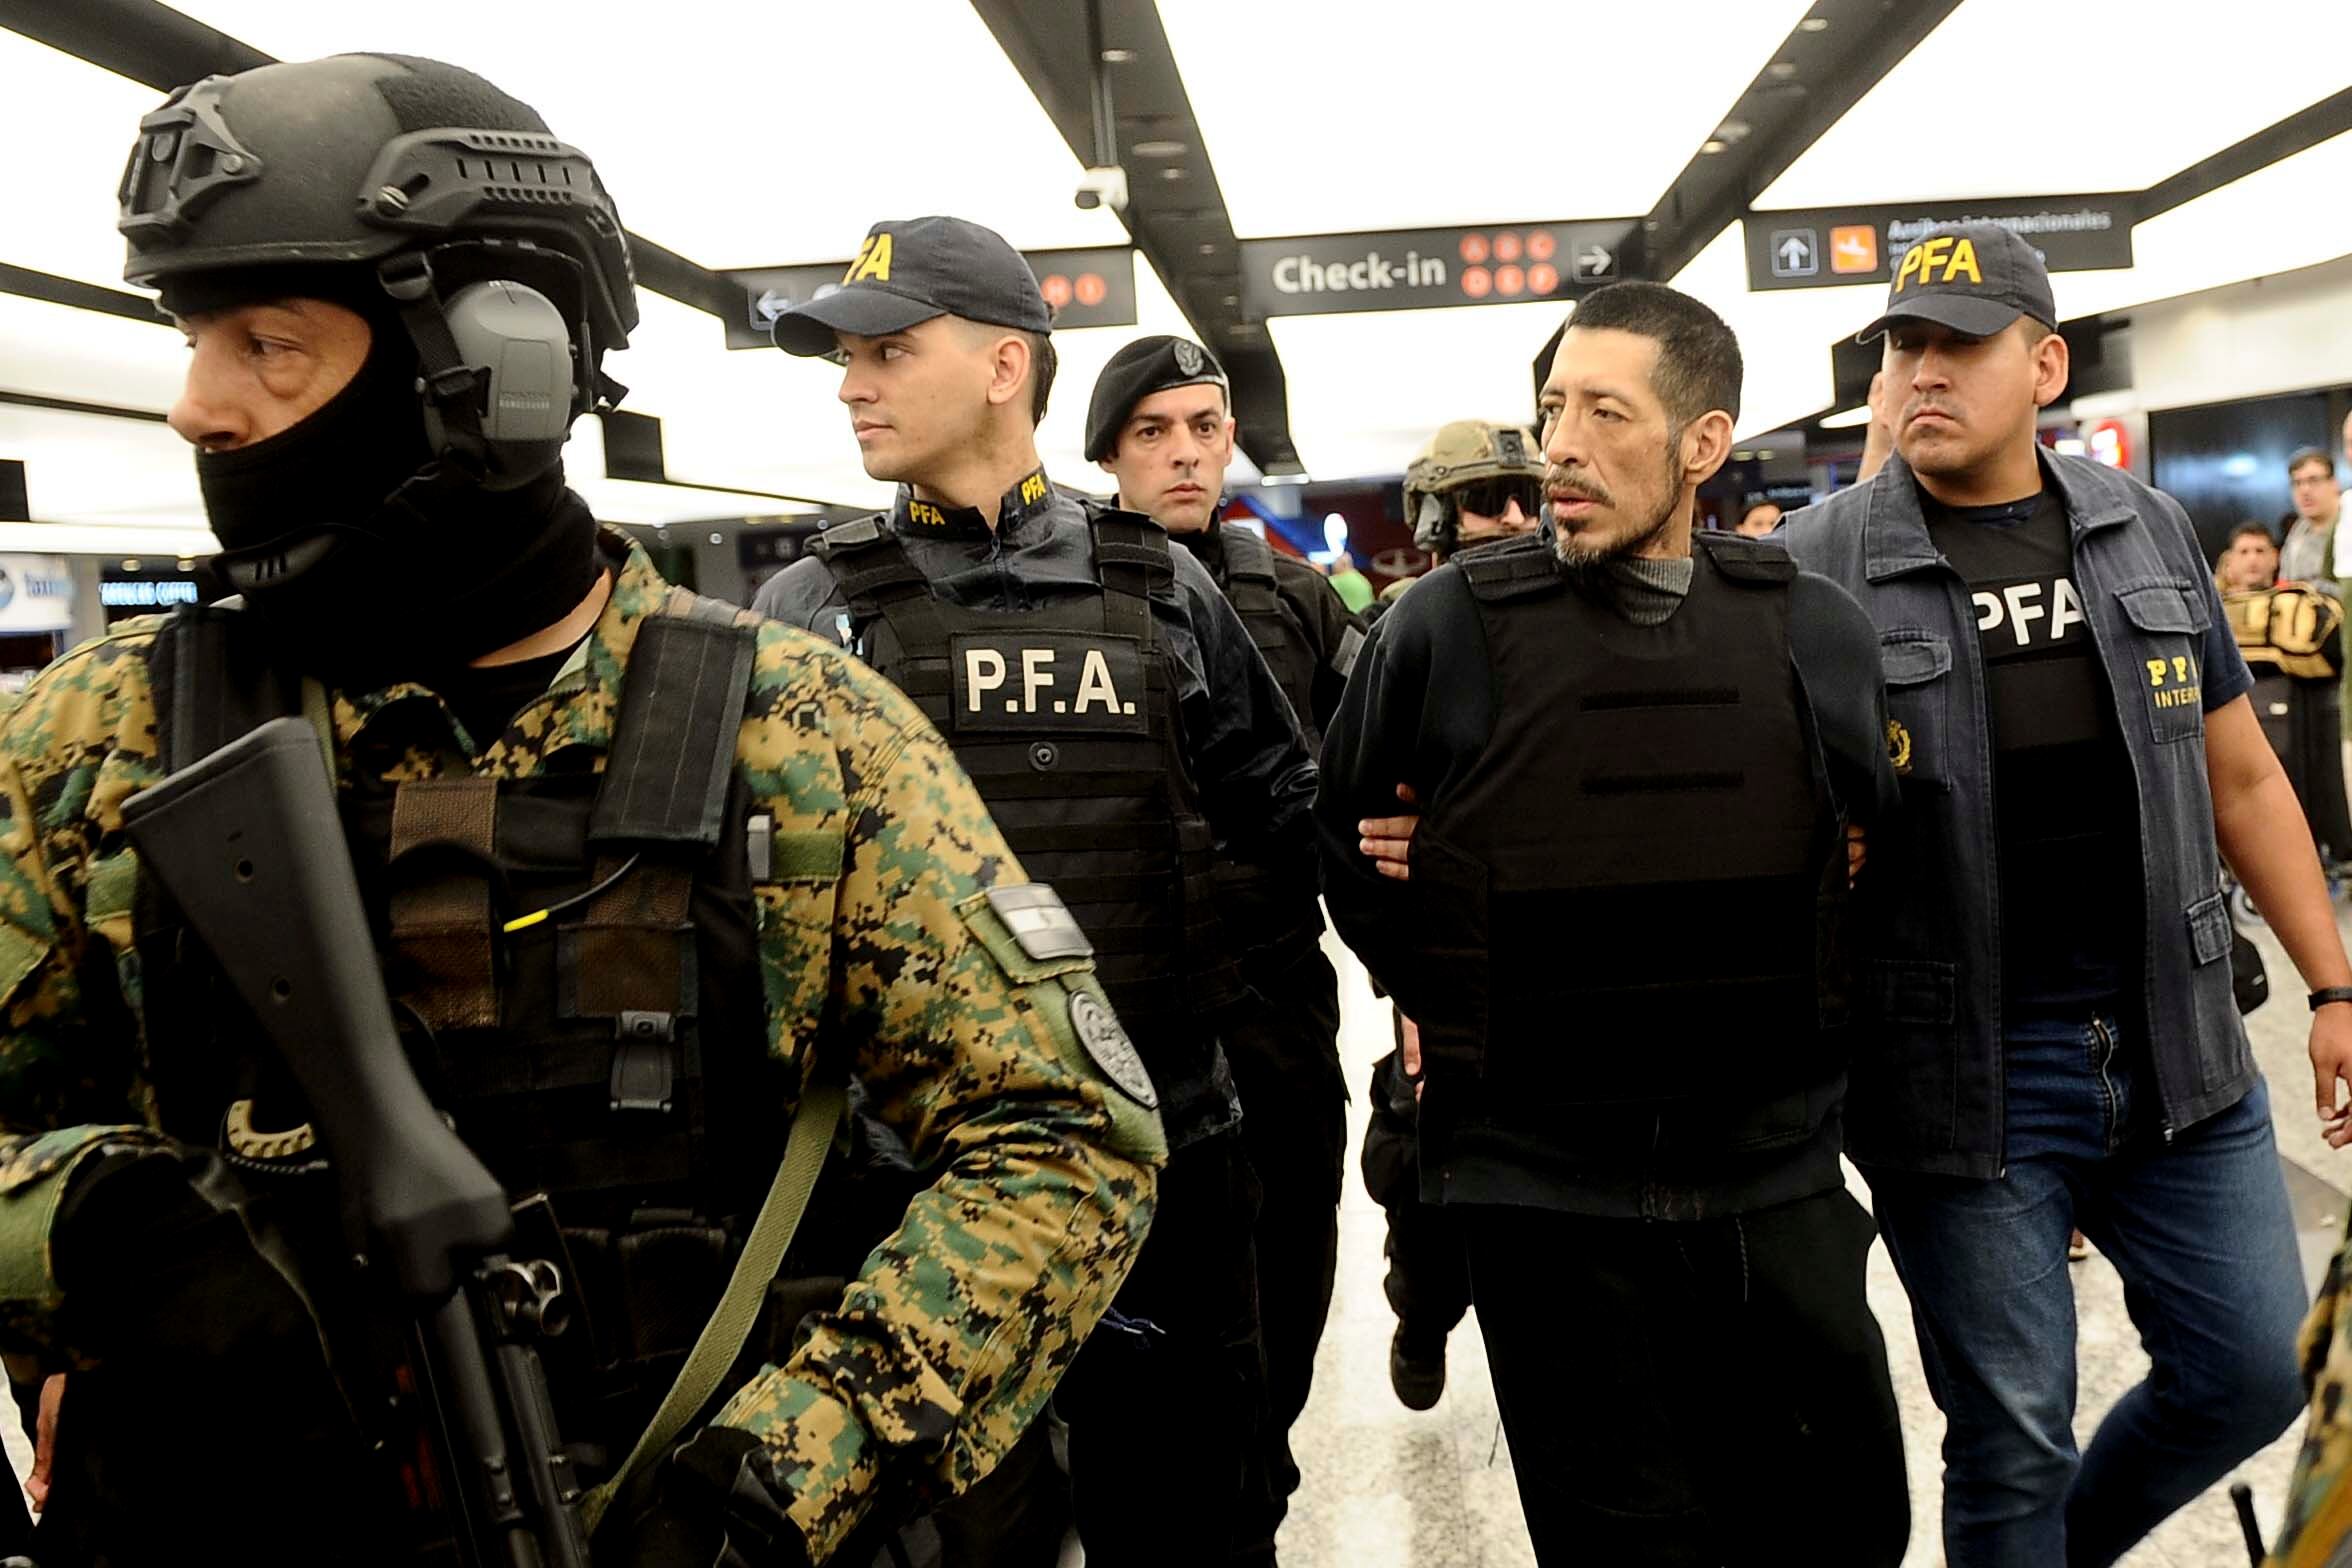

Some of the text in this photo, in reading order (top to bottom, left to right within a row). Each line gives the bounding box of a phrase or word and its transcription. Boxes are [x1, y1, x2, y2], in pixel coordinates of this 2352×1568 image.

[1272, 251, 1447, 293] Check-in
[1895, 236, 1982, 294] PFA
[908, 500, 946, 527] PFA
[1021, 472, 1046, 506] PFA
[1971, 577, 2087, 647] PFA
[965, 648, 1137, 716] P.F.A.
